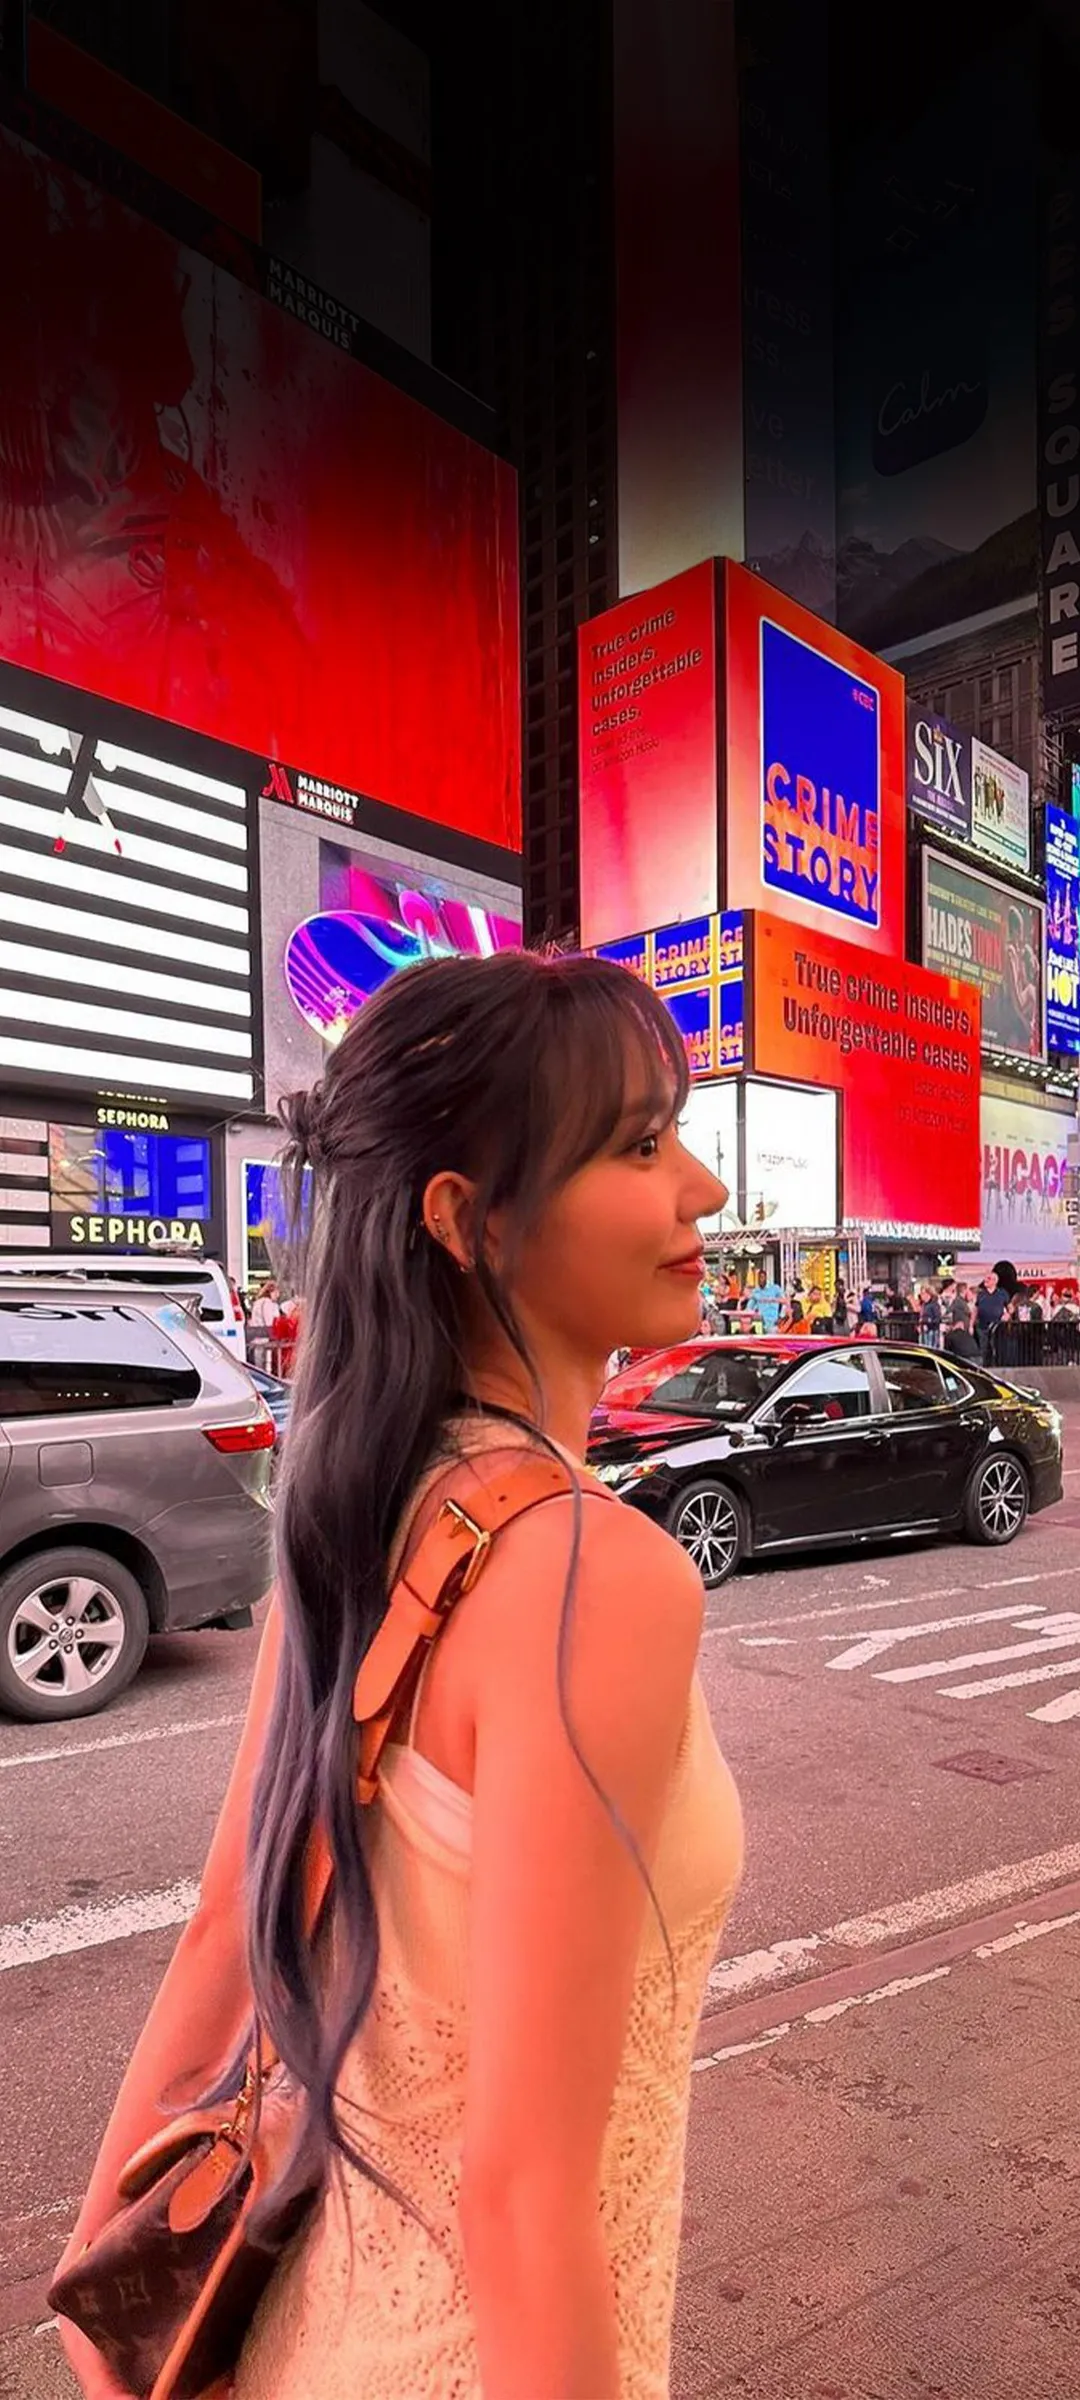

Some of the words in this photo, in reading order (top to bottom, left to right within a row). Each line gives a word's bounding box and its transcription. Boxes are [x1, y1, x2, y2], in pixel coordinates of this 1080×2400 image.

[269, 258, 360, 333] MARRIOTT
[270, 282, 350, 350] MARQUIS
[876, 368, 982, 437] Calm
[1045, 372, 1080, 676] SQUARE
[592, 633, 626, 660] True
[628, 609, 676, 643] crime
[592, 648, 703, 712] Unforgettable
[592, 705, 642, 737] cases.
[297, 774, 360, 809] MARRIOTT
[297, 791, 354, 823] MARQUIS
[766, 762, 879, 851] CRIME
[763, 821, 879, 912] STORY
[655, 957, 711, 983] STORY
[656, 934, 711, 963] CRIME
[795, 952, 841, 997] True
[846, 974, 899, 1014] crime
[1047, 963, 1080, 1010] HOT
[784, 995, 918, 1062] Unforgettable
[922, 1042, 972, 1078] cases.
[97, 1107, 169, 1130] SEPHORA
[983, 1143, 1069, 1199] HICAG
[70, 1215, 204, 1247] SEPHORA
